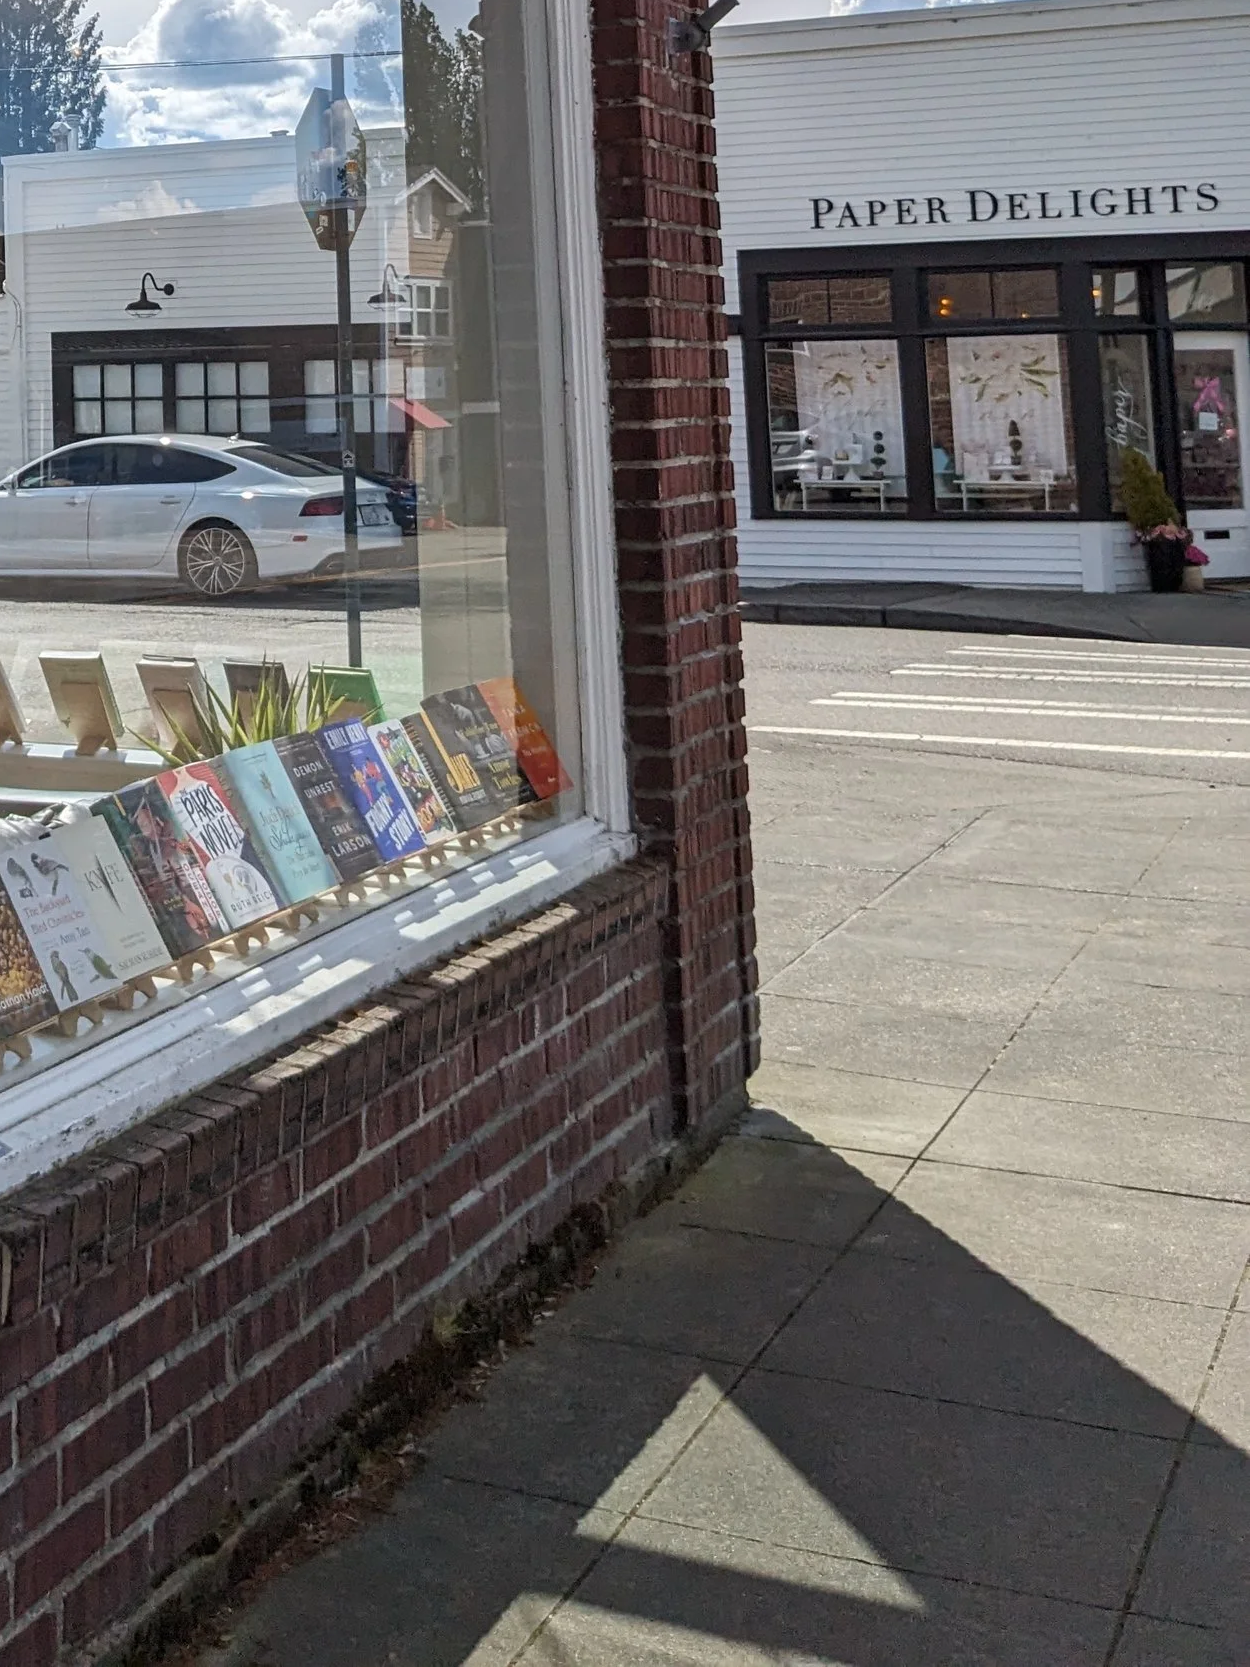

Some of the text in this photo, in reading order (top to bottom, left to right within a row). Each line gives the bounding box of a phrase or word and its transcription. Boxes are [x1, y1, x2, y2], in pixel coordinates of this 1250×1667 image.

[808, 183, 1220, 230] PAPER DELIGHTS
[293, 760, 324, 778] DEMON
[304, 780, 336, 800] UNREST
[180, 783, 225, 828] PARIS
[199, 814, 244, 861] NOVEL
[331, 821, 353, 836] ERIK
[331, 835, 372, 857] LARSON
[230, 900, 250, 914] RUTH
